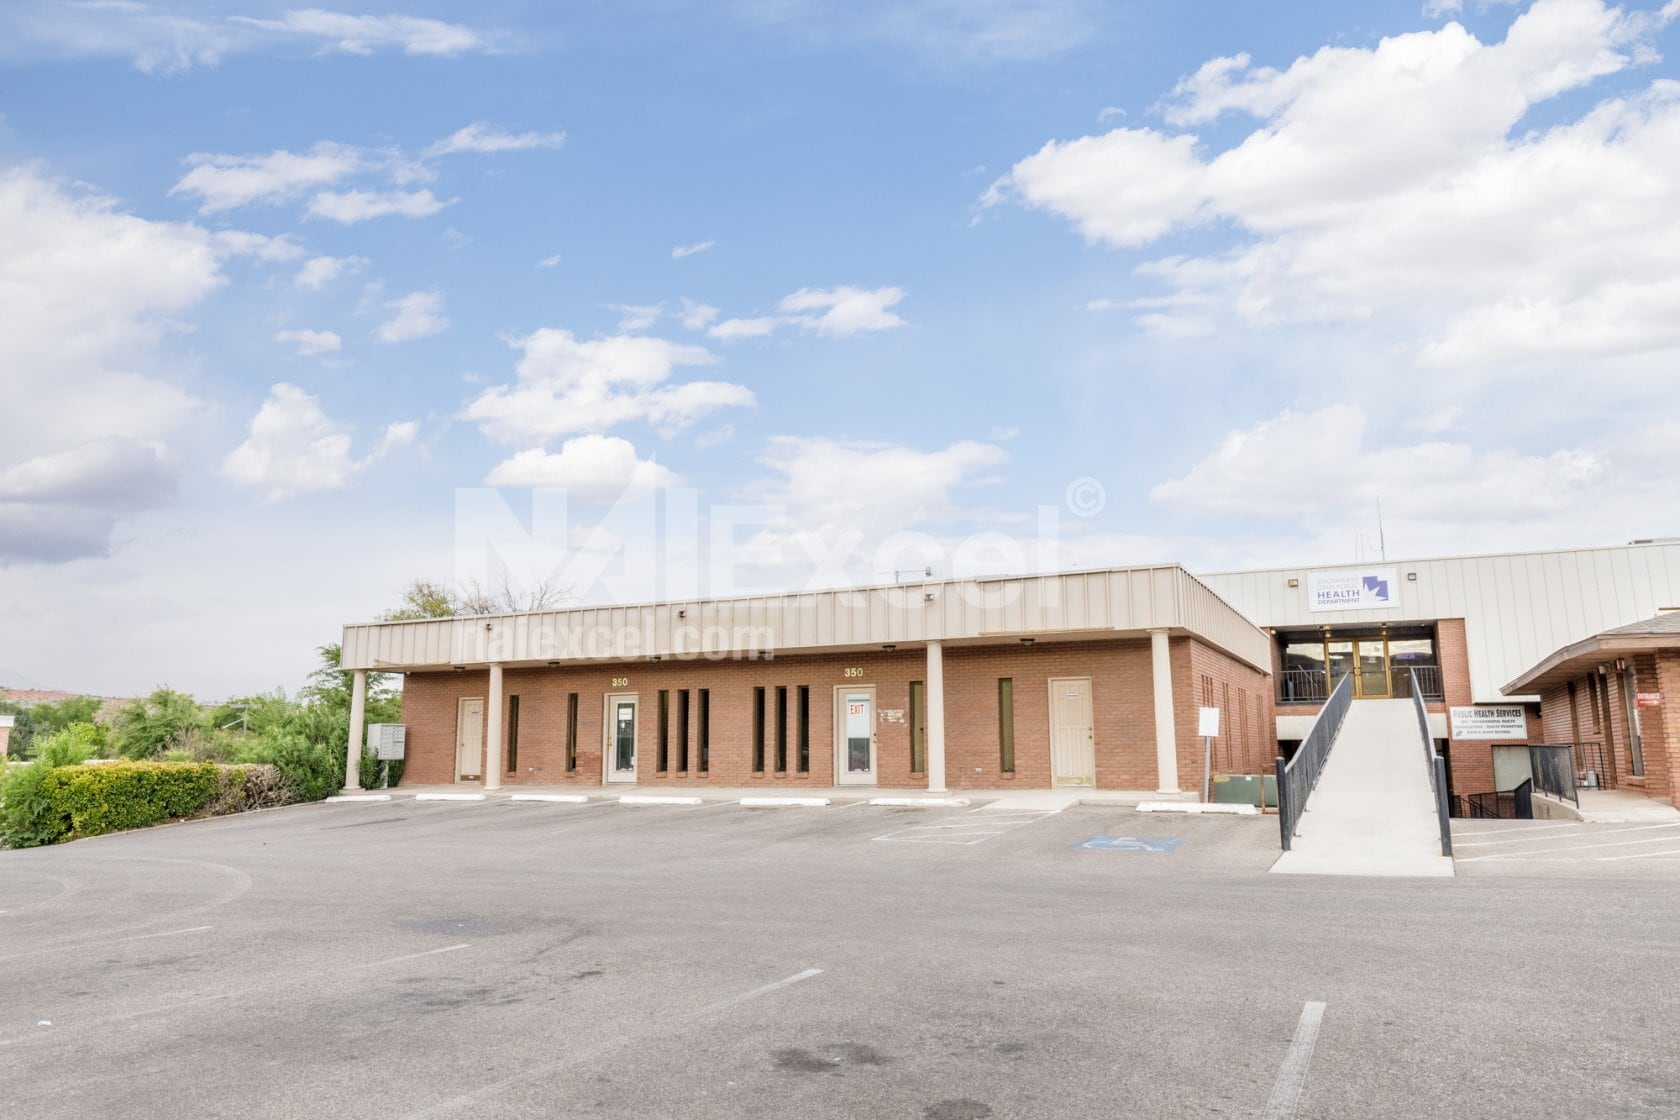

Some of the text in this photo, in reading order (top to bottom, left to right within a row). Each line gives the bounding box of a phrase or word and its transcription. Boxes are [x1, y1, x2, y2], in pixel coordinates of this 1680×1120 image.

[1317, 590, 1360, 599] HEALTH
[844, 667, 863, 678] 350
[612, 677, 628, 687] 350
[850, 704, 865, 715] EXIT
[1453, 708, 1522, 718] PUBLIC HEALTH SERVICES
